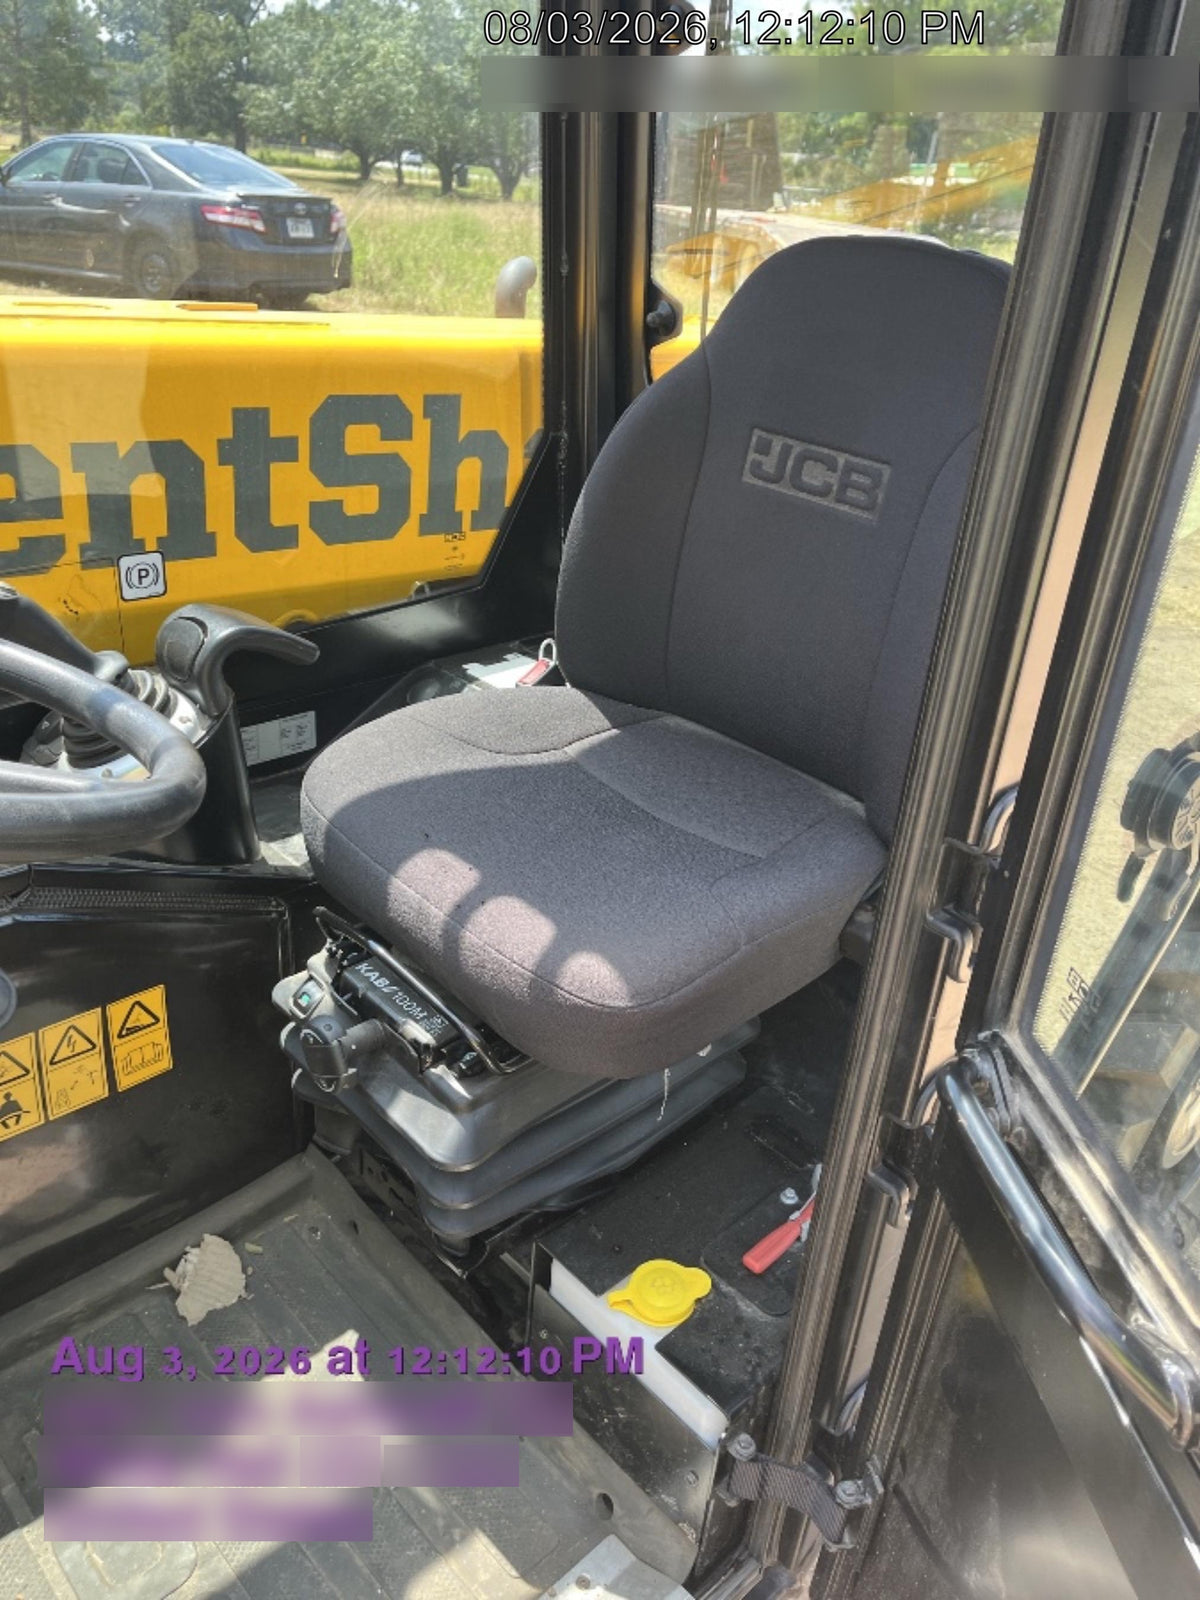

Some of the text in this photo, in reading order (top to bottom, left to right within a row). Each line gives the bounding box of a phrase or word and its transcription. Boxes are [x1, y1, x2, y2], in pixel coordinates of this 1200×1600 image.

[0, 394, 544, 578] entSh
[747, 434, 886, 514] JCB
[138, 568, 150, 586] P
